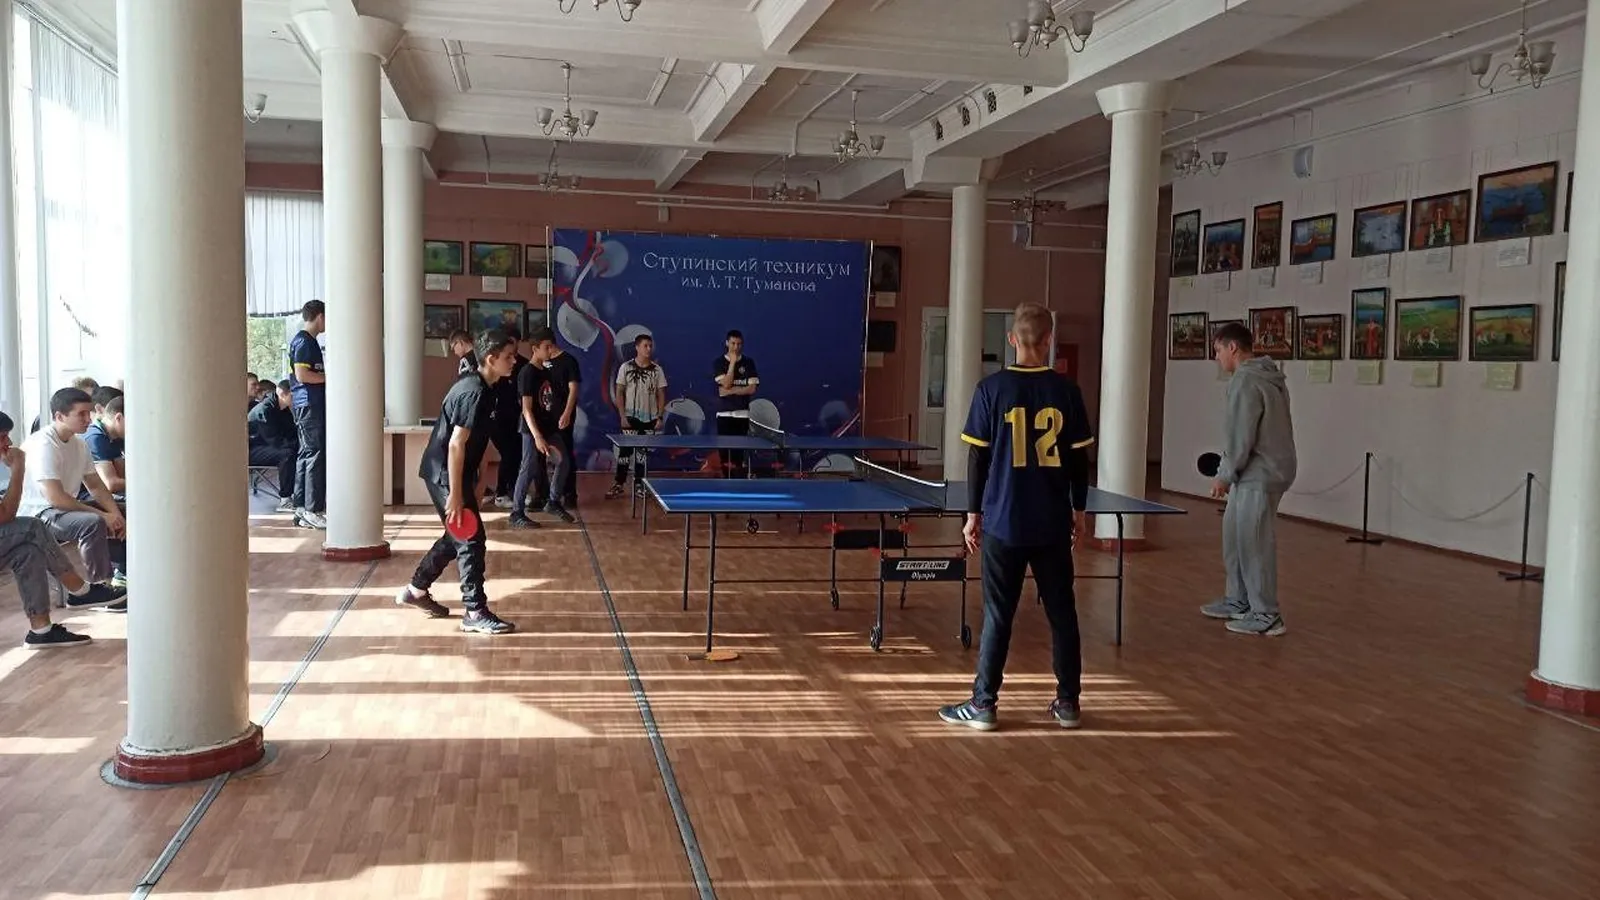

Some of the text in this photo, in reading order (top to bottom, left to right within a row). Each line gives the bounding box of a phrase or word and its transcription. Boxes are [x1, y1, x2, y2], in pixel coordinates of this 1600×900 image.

[643, 252, 850, 279] Ступинский техникум
[681, 276, 816, 293] им. А. Т. Туманова
[1004, 407, 1064, 467] 12
